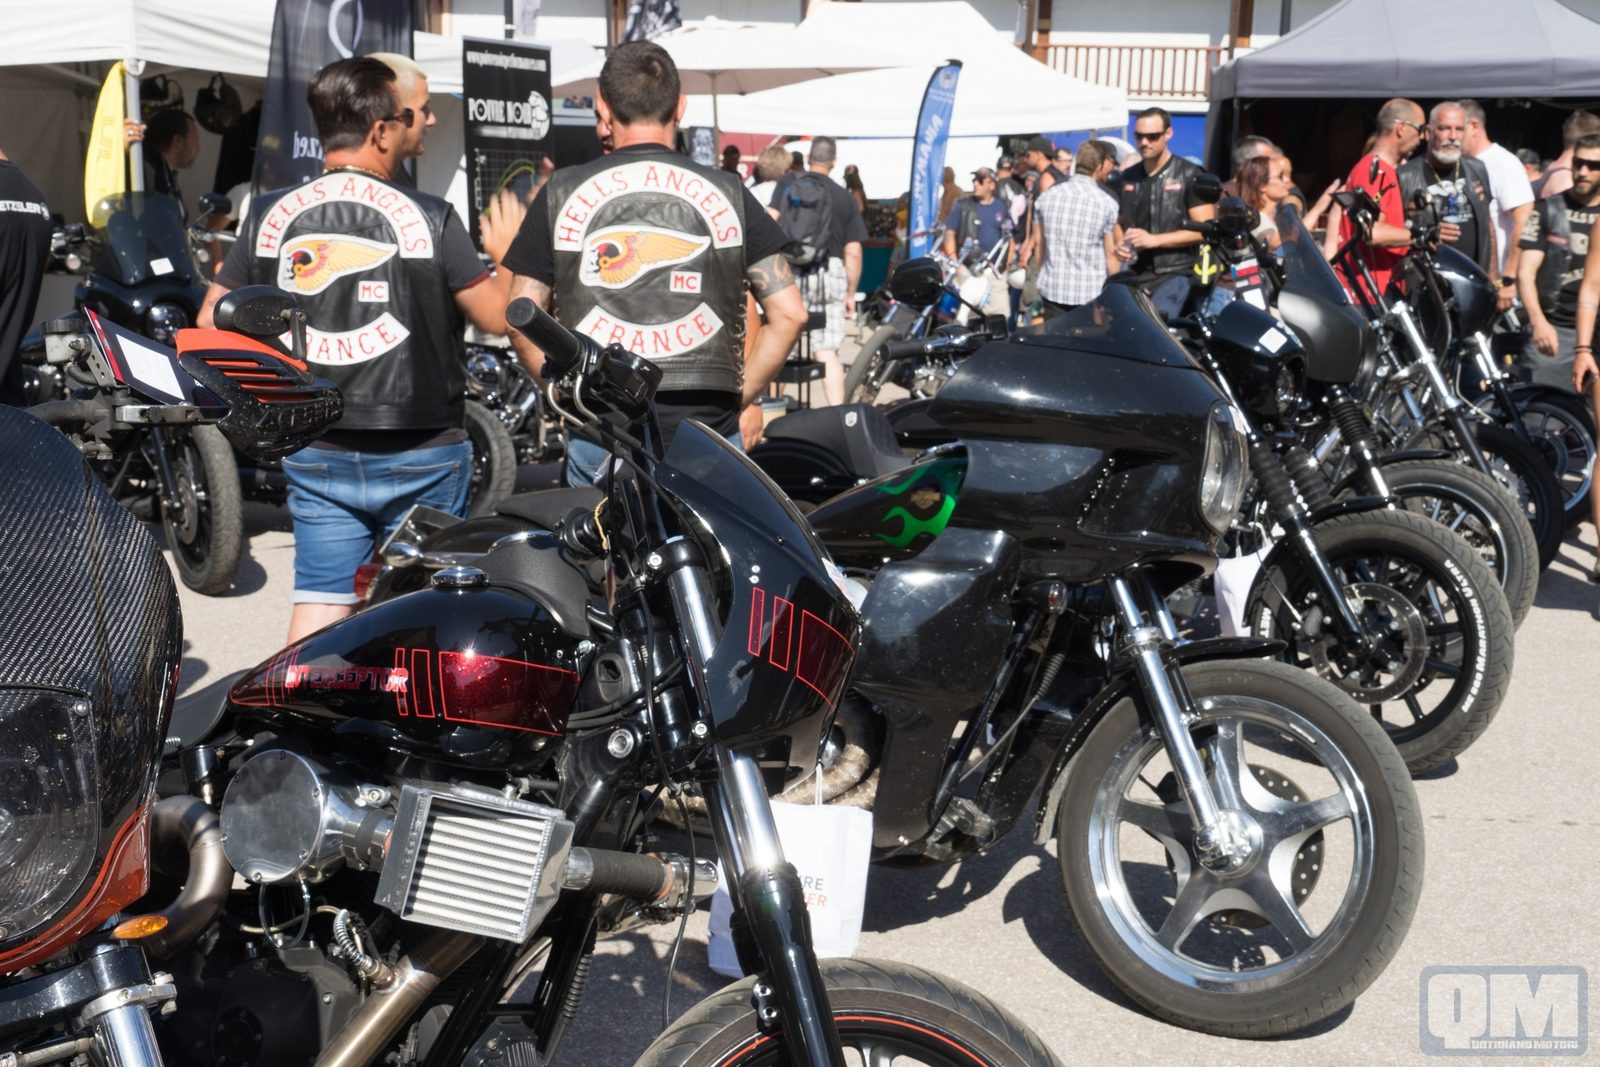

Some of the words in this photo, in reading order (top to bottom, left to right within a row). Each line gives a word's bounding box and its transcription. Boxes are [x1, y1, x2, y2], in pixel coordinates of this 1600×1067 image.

[260, 182, 327, 250] HELLS
[340, 176, 428, 252] ANGELS
[559, 171, 629, 244] HELLS
[644, 166, 738, 243] ANGELS
[361, 284, 385, 299] MC
[673, 274, 698, 290] MC
[588, 312, 714, 354] FRANCE
[1444, 559, 1473, 598] ULTRA
